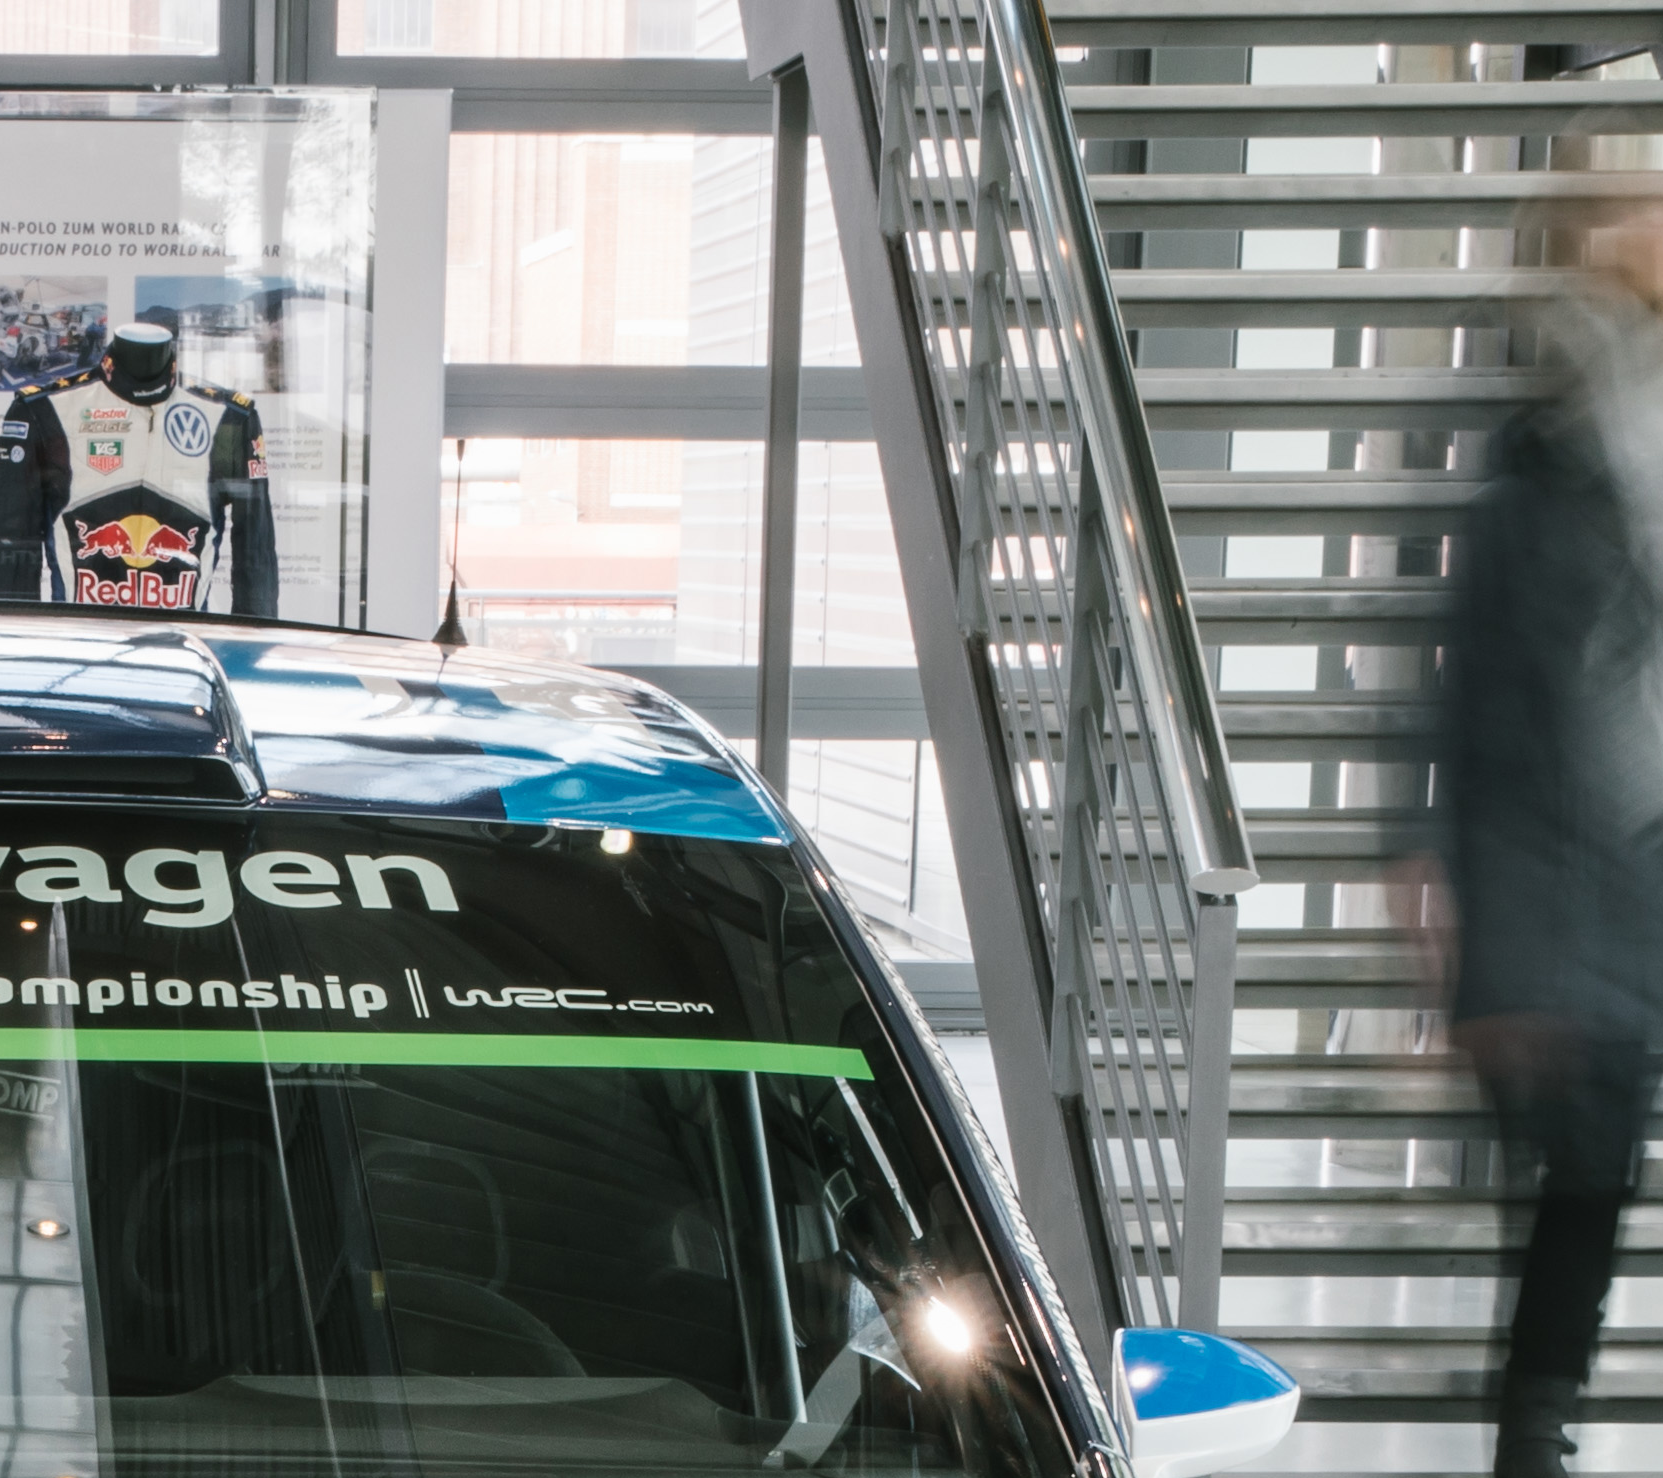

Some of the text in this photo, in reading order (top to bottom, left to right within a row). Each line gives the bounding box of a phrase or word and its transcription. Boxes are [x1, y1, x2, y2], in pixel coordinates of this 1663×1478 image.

[63, 222, 95, 235] ZUM
[101, 221, 156, 235] WORLD
[71, 243, 112, 257] POLO
[118, 243, 138, 257] TO
[144, 242, 198, 257] WORLD
[93, 409, 128, 420] Castrol
[93, 442, 118, 455] TAG
[78, 569, 197, 608] Red Bull
